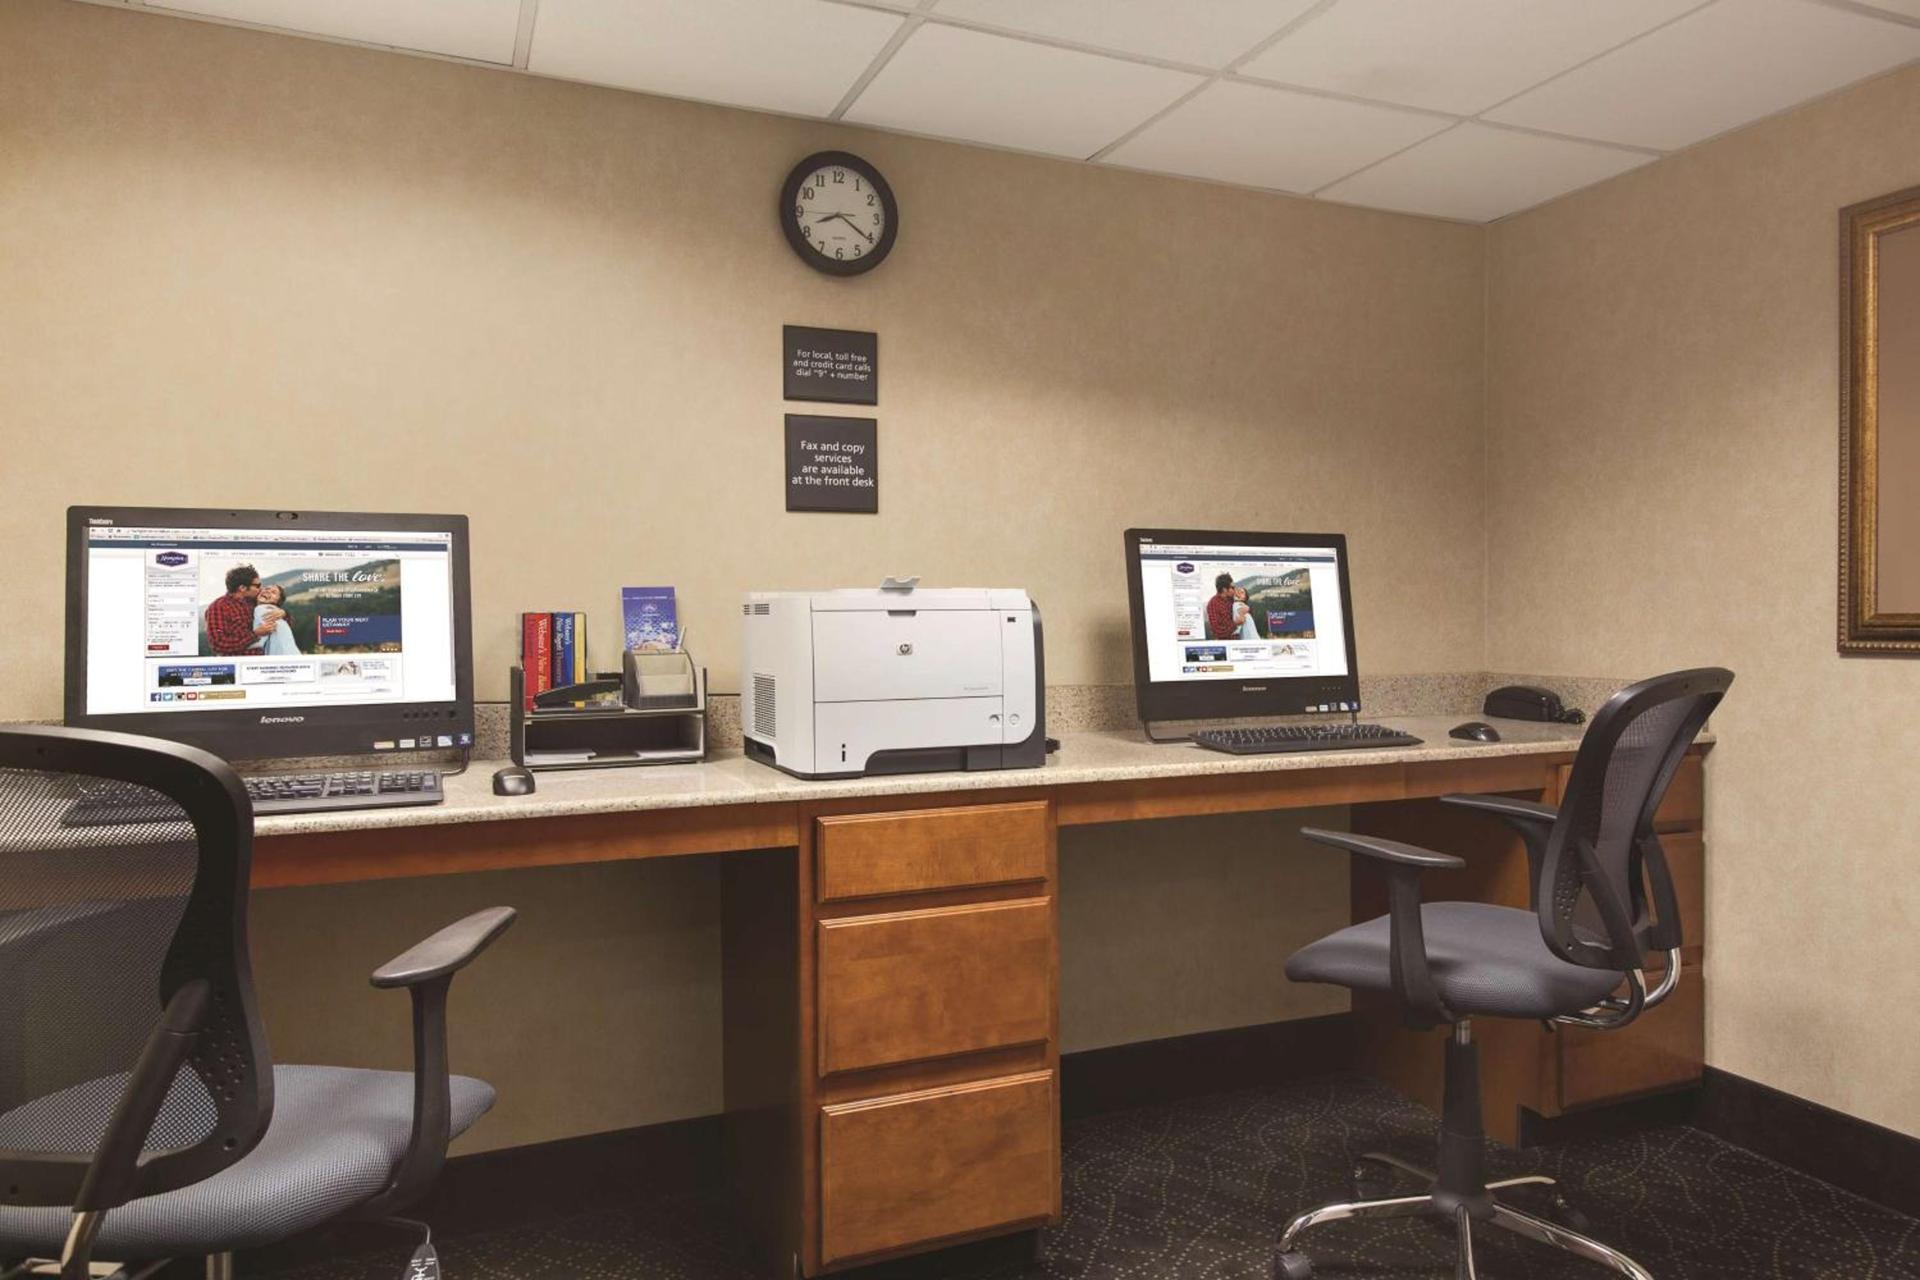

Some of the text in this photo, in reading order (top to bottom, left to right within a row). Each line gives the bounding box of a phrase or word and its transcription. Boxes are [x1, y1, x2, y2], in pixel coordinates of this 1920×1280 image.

[815, 175, 826, 188] 11
[832, 170, 845, 184] 12
[855, 179, 860, 192] 1
[802, 187, 814, 200] 10
[867, 194, 874, 206] 2
[796, 206, 804, 218] 9
[872, 214, 880, 226] 3
[803, 226, 811, 238] 8
[866, 232, 874, 244] 4
[818, 241, 826, 254] 7
[836, 248, 843, 260] 6
[854, 244, 861, 257] 5
[797, 349, 867, 362] For local, toll free
[793, 359, 871, 372] and credit card calls
[796, 368, 812, 377] dial
[837, 372, 868, 381] number
[800, 440, 865, 454] Fax and copy
[814, 454, 852, 463] services
[801, 465, 864, 476] are available
[792, 475, 874, 487] at the front desk
[302, 572, 329, 582] SHARE
[334, 572, 349, 582] THE
[538, 618, 547, 654] Webster's
[538, 655, 547, 674] New
[260, 716, 304, 724] lenovo
